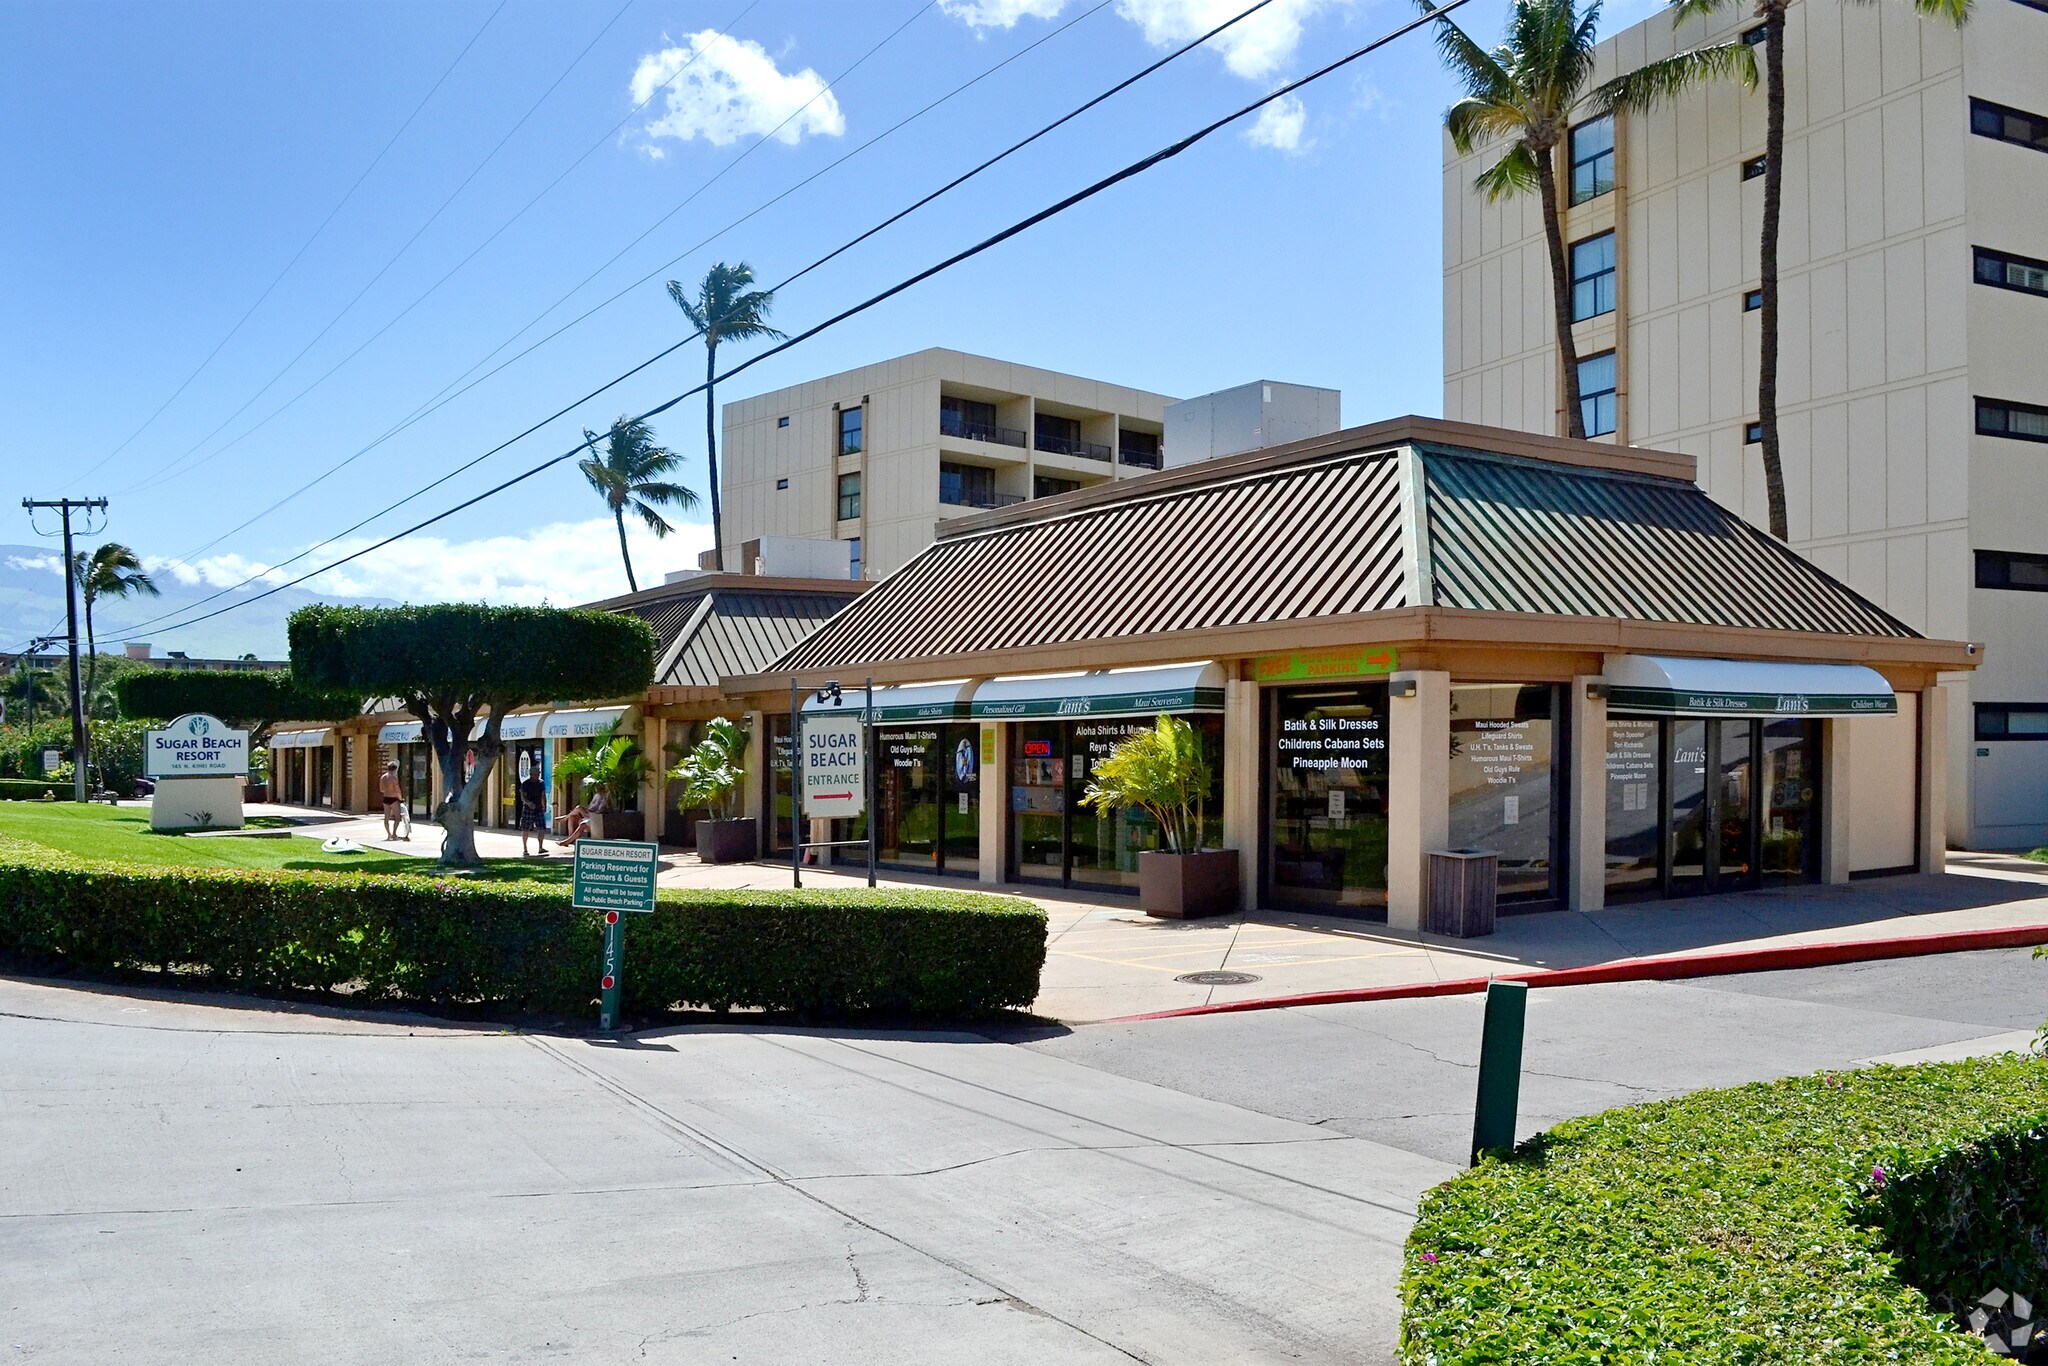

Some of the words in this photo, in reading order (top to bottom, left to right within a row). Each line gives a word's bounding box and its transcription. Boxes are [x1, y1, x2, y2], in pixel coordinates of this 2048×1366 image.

[1307, 663, 1358, 675] PARKING
[1057, 697, 1091, 715] Lani's
[1133, 698, 1151, 708] Maui
[1151, 696, 1183, 707] Souvenirs
[1689, 697, 1705, 707] Batik
[1706, 698, 1712, 707] &
[1713, 698, 1724, 707] Silk
[1725, 699, 1748, 708] Dresses
[1775, 696, 1809, 712] Lani's
[1851, 699, 1874, 709] Children
[1874, 701, 1888, 709] Wear
[982, 705, 1014, 714] Personalized
[1014, 704, 1026, 713] Gift
[1284, 720, 1307, 731] Batik
[1309, 719, 1317, 730] &
[1319, 718, 1337, 730] Silk
[1339, 719, 1379, 730] Dresses
[880, 732, 904, 740] Humorous
[905, 731, 917, 740] Maui
[917, 731, 937, 740] T-Shirts
[1076, 726, 1096, 736] Aloha
[1097, 725, 1118, 735] Shirts
[1120, 725, 1126, 735] &
[809, 734, 857, 748] SUGAR
[1481, 732, 1507, 741] Lifeguard
[1507, 732, 1523, 740] Shirts
[156, 737, 198, 749] SUGAR
[202, 737, 241, 749] BEACH
[1025, 743, 1049, 754] OPEN
[1089, 742, 1107, 753] Reyn
[1278, 738, 1322, 749] Childrens
[1324, 738, 1360, 749] Cabana
[1363, 737, 1385, 749] Sets
[1493, 743, 1509, 751] Tanks
[1515, 743, 1534, 751] Sweats
[890, 745, 899, 754] Old
[900, 745, 912, 755] Guys
[913, 745, 925, 754] Rule
[1674, 747, 1706, 763] Lani's
[176, 751, 221, 761] RESORT
[811, 752, 856, 767] BEACH
[894, 758, 913, 767] Woodie
[913, 758, 921, 767] T's
[1293, 757, 1339, 771] Pineapple
[1341, 757, 1368, 768] Moon
[1494, 766, 1508, 774] Guys
[808, 773, 860, 786] ENTRANCE
[1487, 776, 1507, 784] Woodie
[1508, 776, 1516, 784] T's
[581, 847, 603, 856] SUGAR
[604, 849, 625, 858] BEACH
[626, 850, 651, 859] RESORT
[581, 861, 606, 872] Parking
[607, 863, 638, 872] Reserved
[638, 865, 650, 873] for
[581, 871, 616, 882] Customers
[617, 873, 623, 882] &
[624, 874, 648, 884] Guests
[584, 886, 592, 894] All
[592, 887, 609, 895] others
[609, 888, 619, 896] will
[627, 889, 644, 897] towed
[591, 896, 607, 904] Public
[607, 897, 623, 905] Beach
[623, 898, 643, 907] Parking
